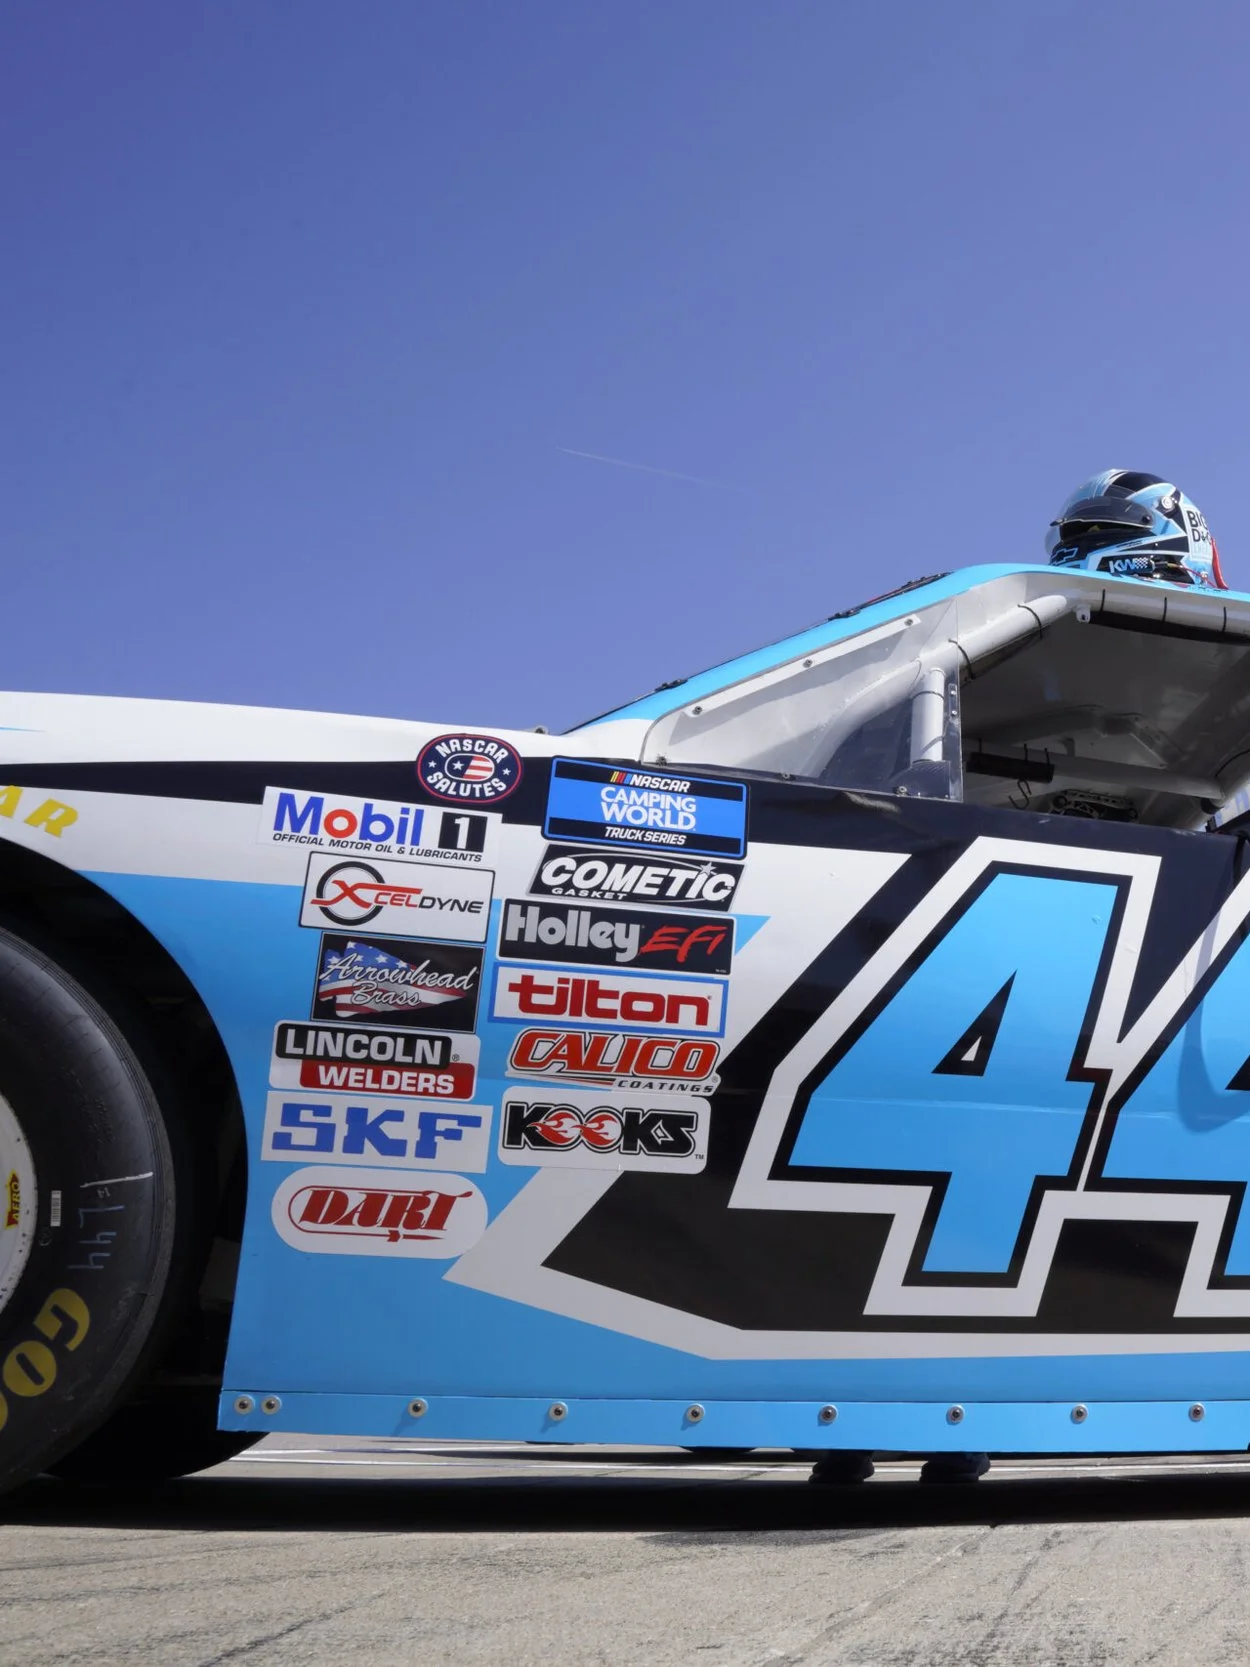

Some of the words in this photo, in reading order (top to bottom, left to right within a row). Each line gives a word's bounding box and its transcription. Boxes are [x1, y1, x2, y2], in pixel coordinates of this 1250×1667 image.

[435, 739, 508, 764] NASCAR
[427, 771, 506, 797] SALUTES
[600, 787, 697, 812] CAMPING
[629, 774, 691, 793] NASCAR
[273, 792, 424, 846] Mobil
[601, 802, 696, 831] WORLD
[272, 833, 325, 846] OFFICIAL
[328, 839, 372, 852] MOTOR
[375, 844, 394, 854] OIL
[397, 847, 405, 855] &
[409, 848, 484, 863] LUBRICANTS
[604, 826, 645, 841] TRUCK
[645, 831, 687, 845] SERIES
[541, 856, 736, 901] COMETIC
[551, 888, 627, 900] GASKET
[310, 879, 484, 914] XCELDYNE
[505, 903, 641, 962] Holley
[639, 925, 728, 963] EFI
[319, 953, 478, 990] Arrowhead
[351, 980, 421, 1006] Brass
[508, 974, 710, 1026] tilton
[285, 1029, 442, 1065] LINCOLN
[511, 1029, 719, 1080] CALICO
[318, 1065, 455, 1095] WELDERS
[617, 1079, 714, 1093] COATINGS
[271, 1103, 482, 1159] SKF
[502, 1101, 698, 1157] KOOKS
[0, 1288, 90, 1431] GO
